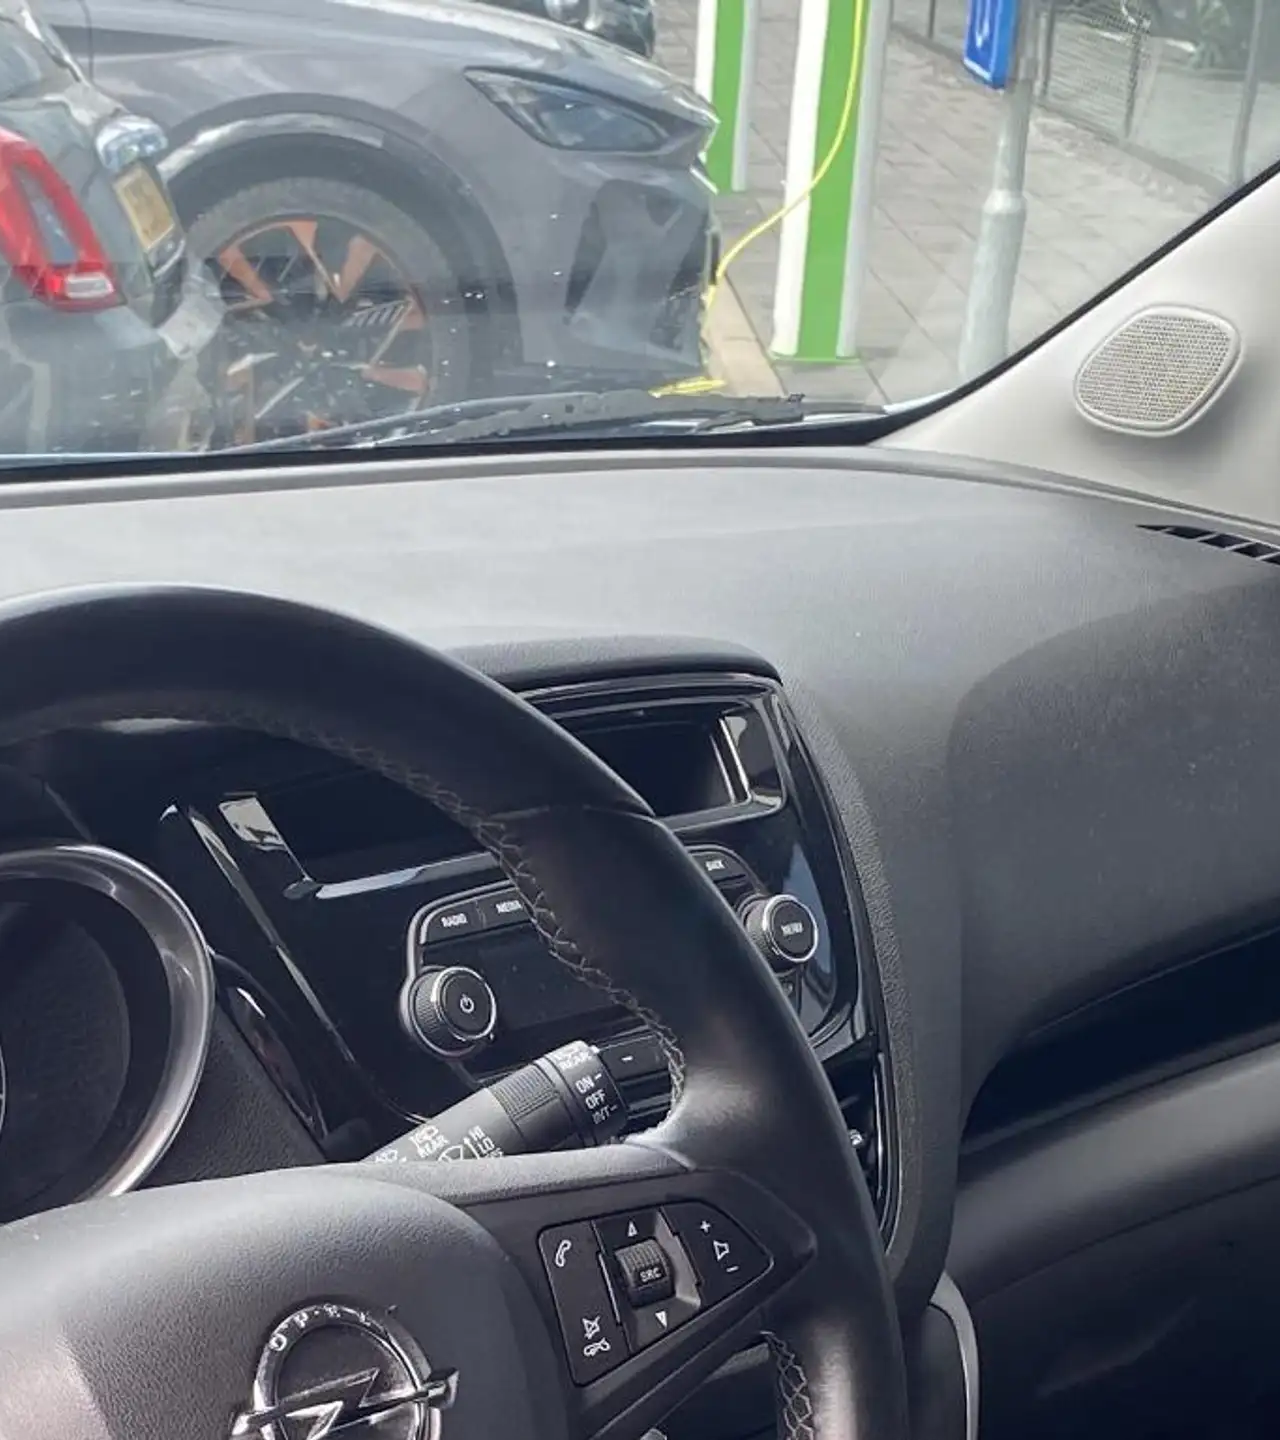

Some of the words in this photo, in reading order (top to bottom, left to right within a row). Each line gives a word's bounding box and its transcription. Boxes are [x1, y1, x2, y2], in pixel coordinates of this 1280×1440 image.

[441, 912, 468, 928] RADIO
[780, 921, 804, 937] MENU
[574, 1075, 596, 1095] ON
[584, 1087, 607, 1110] OFF
[470, 1125, 484, 1141] HI
[477, 1136, 495, 1155] LO
[639, 1266, 662, 1283] SRC
